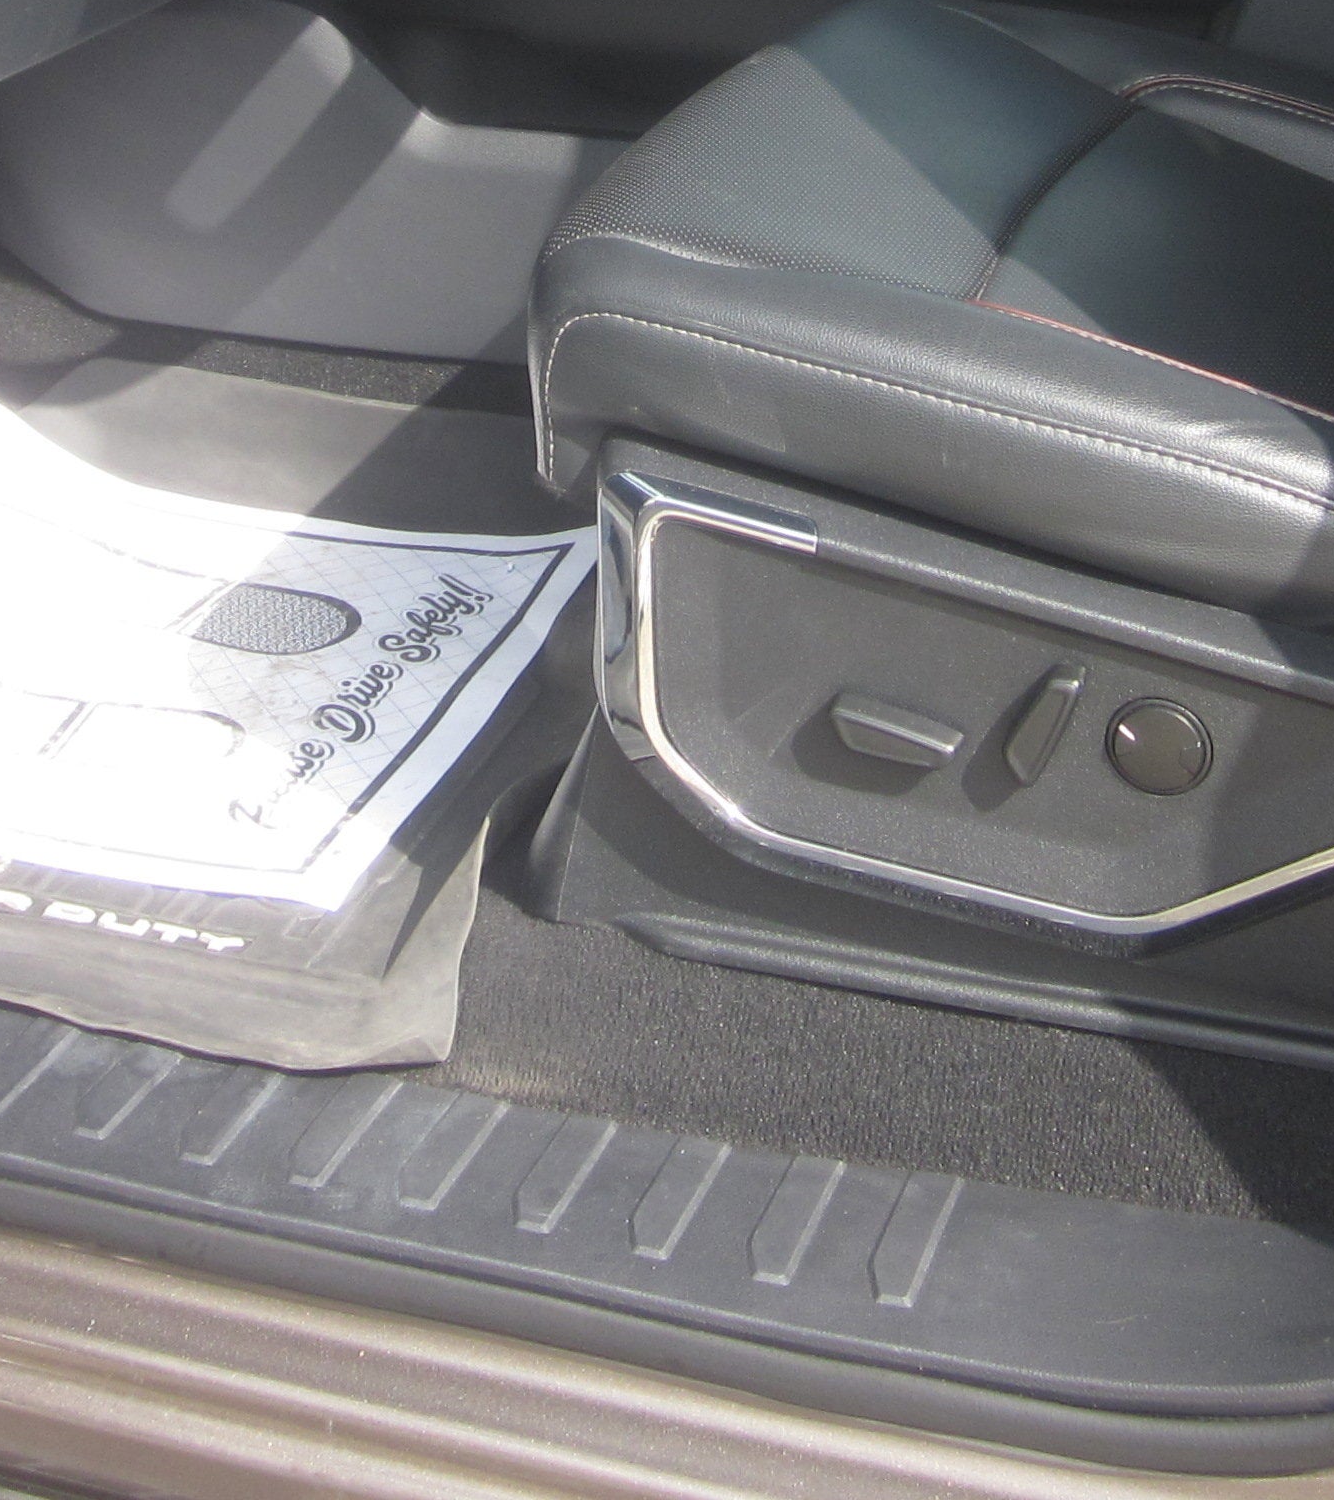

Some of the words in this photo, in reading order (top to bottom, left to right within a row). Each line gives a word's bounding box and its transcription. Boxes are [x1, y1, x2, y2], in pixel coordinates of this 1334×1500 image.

[313, 663, 397, 743] Drive
[377, 573, 490, 663] Safely!
[41, 899, 247, 952] DUTY
